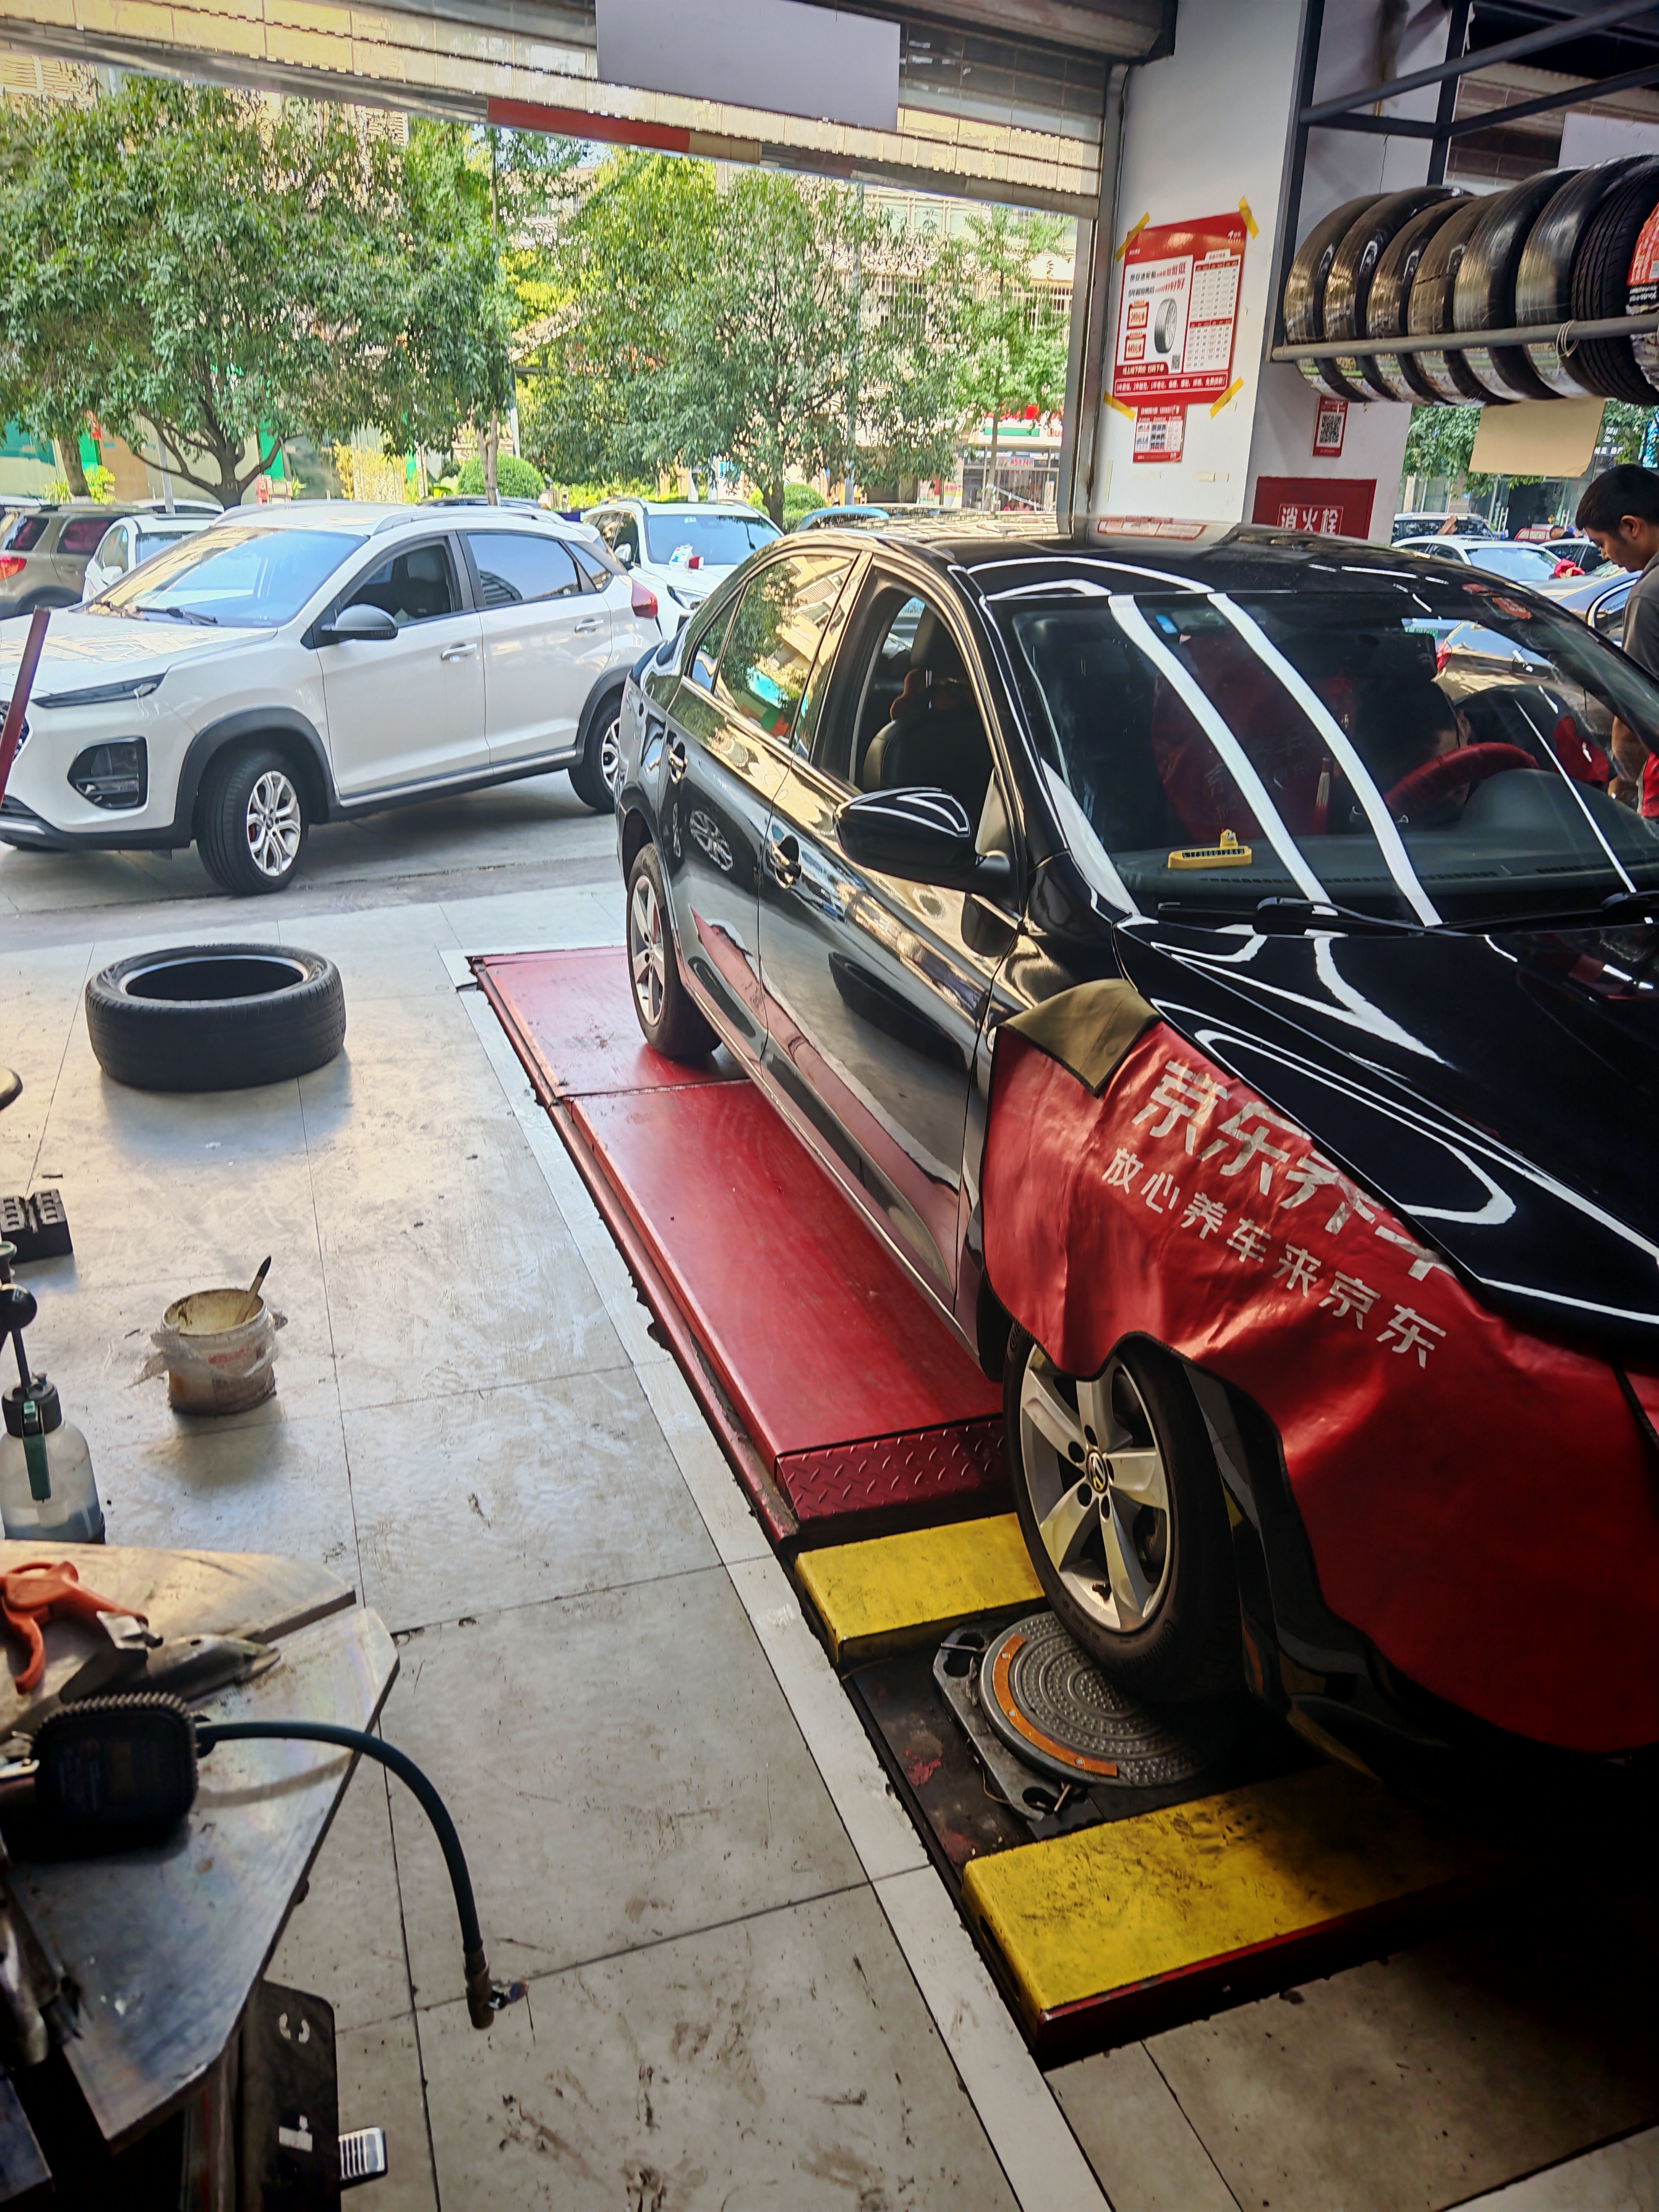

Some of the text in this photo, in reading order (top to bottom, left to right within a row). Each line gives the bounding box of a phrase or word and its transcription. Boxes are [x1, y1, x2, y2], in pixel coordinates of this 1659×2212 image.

[1281, 505, 1338, 535] 消火栓
[1102, 1147, 1447, 1368] 放心养车来京东
